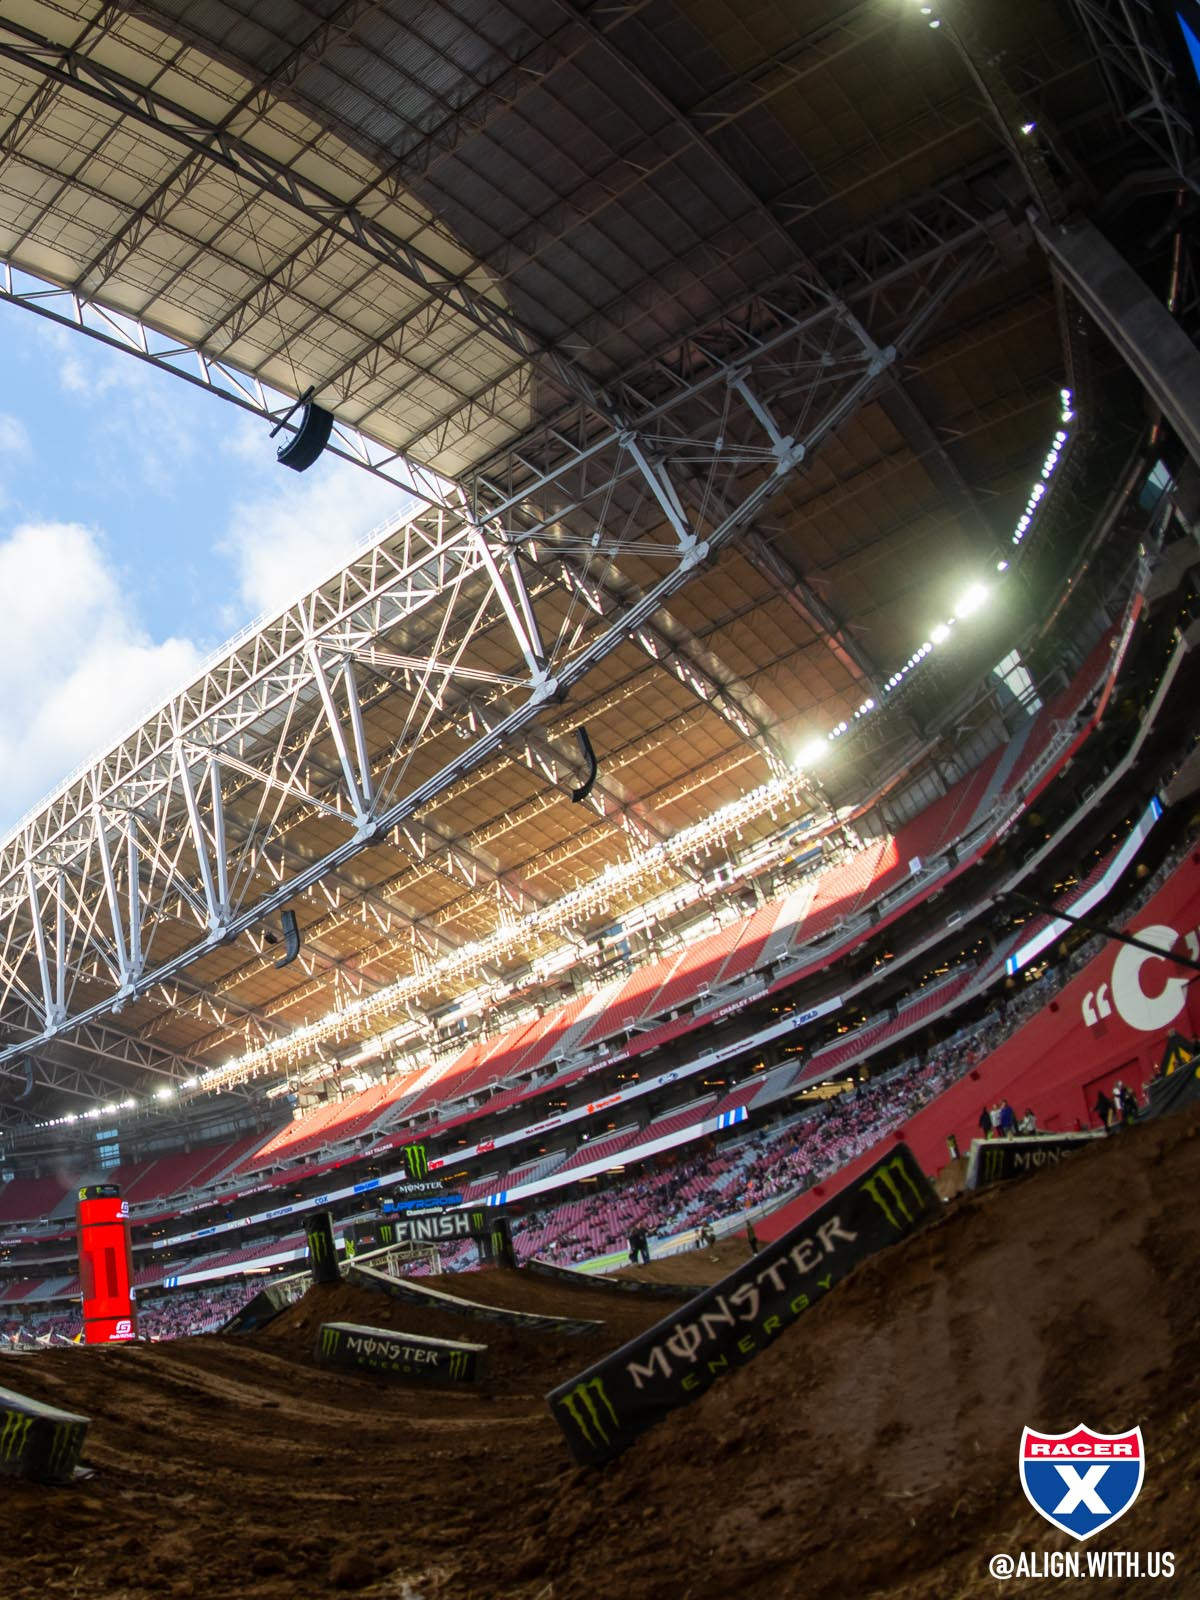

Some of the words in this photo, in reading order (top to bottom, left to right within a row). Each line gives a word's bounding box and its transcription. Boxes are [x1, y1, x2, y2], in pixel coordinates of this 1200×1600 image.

[315, 1196, 328, 1205] COX
[399, 1180, 444, 1194] MONSTER
[395, 1213, 470, 1242] FINISH
[625, 1215, 859, 1389] MONSTER
[681, 1273, 833, 1392] ENERGY
[347, 1336, 439, 1367] MONSTER
[357, 1356, 423, 1374] ENERGY
